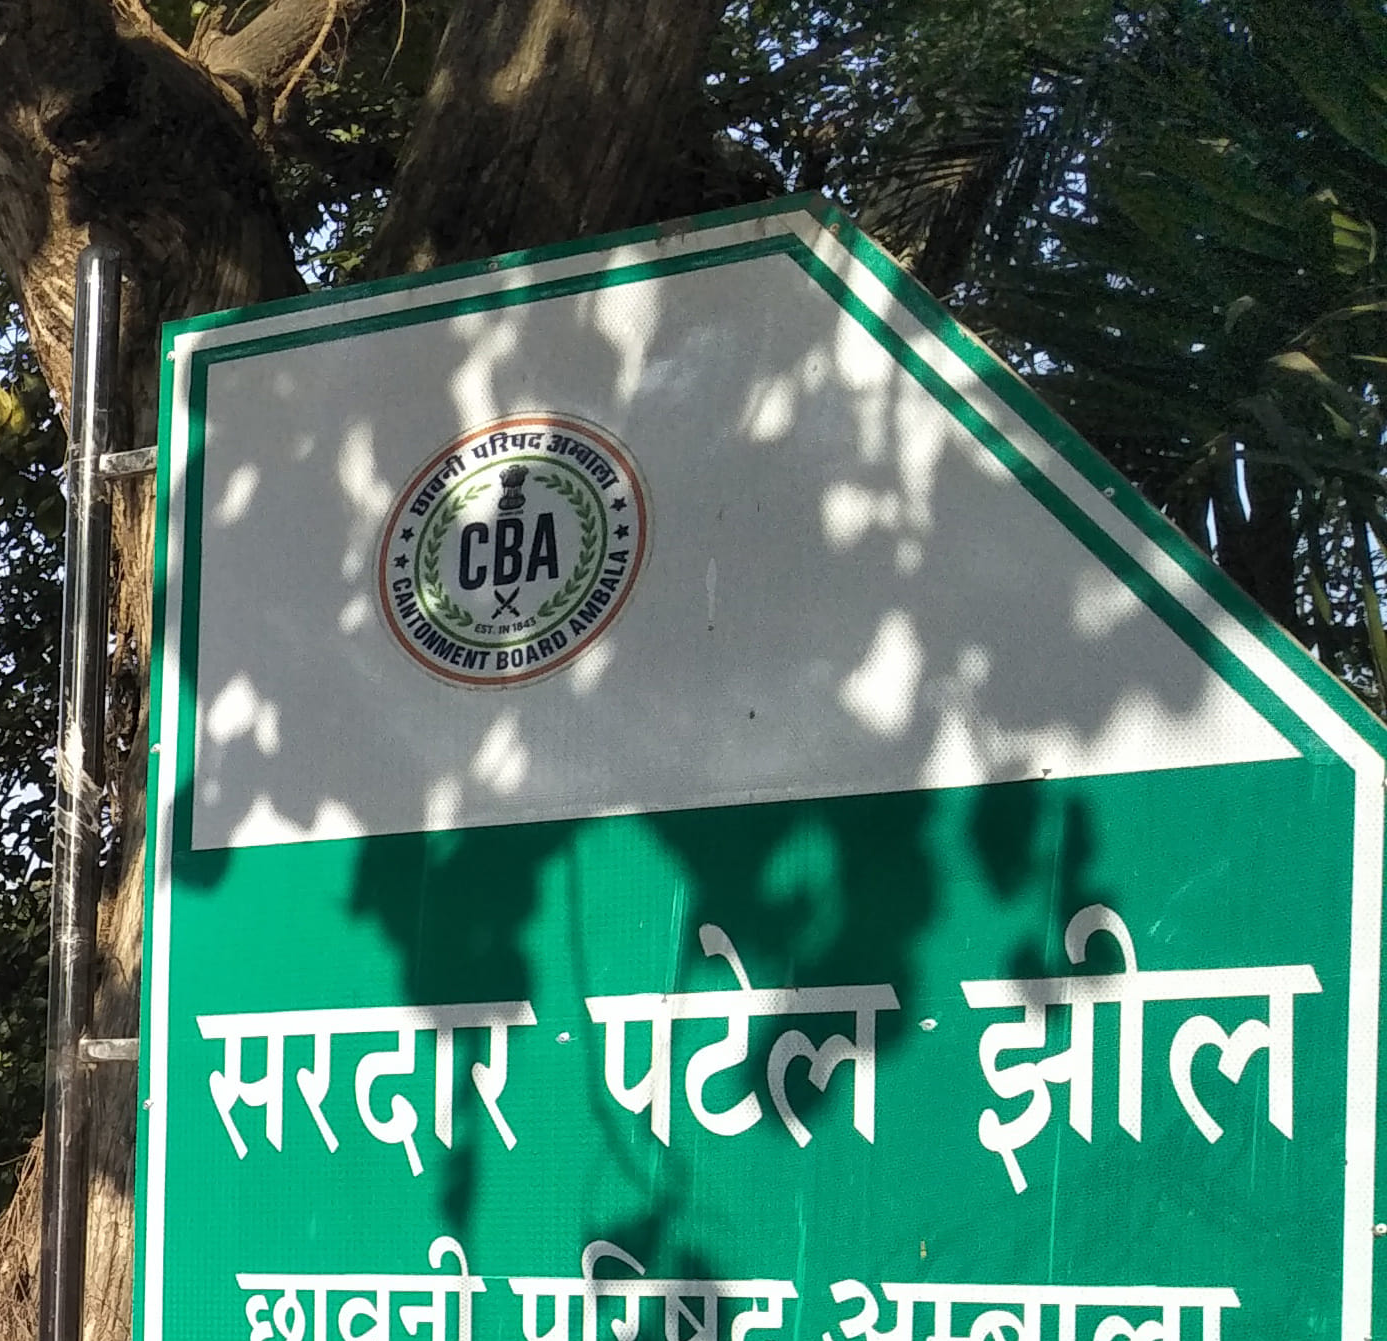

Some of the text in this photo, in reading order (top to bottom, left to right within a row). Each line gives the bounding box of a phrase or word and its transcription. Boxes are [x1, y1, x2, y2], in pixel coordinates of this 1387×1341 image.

[410, 432, 620, 517] छावनी परिषद अम्बाला
[458, 512, 559, 591] CBA
[392, 549, 629, 670] CANTONMENT BOARD AMBALA
[499, 624, 510, 635] IN
[196, 904, 1323, 1194] सरदार पटेल झील
